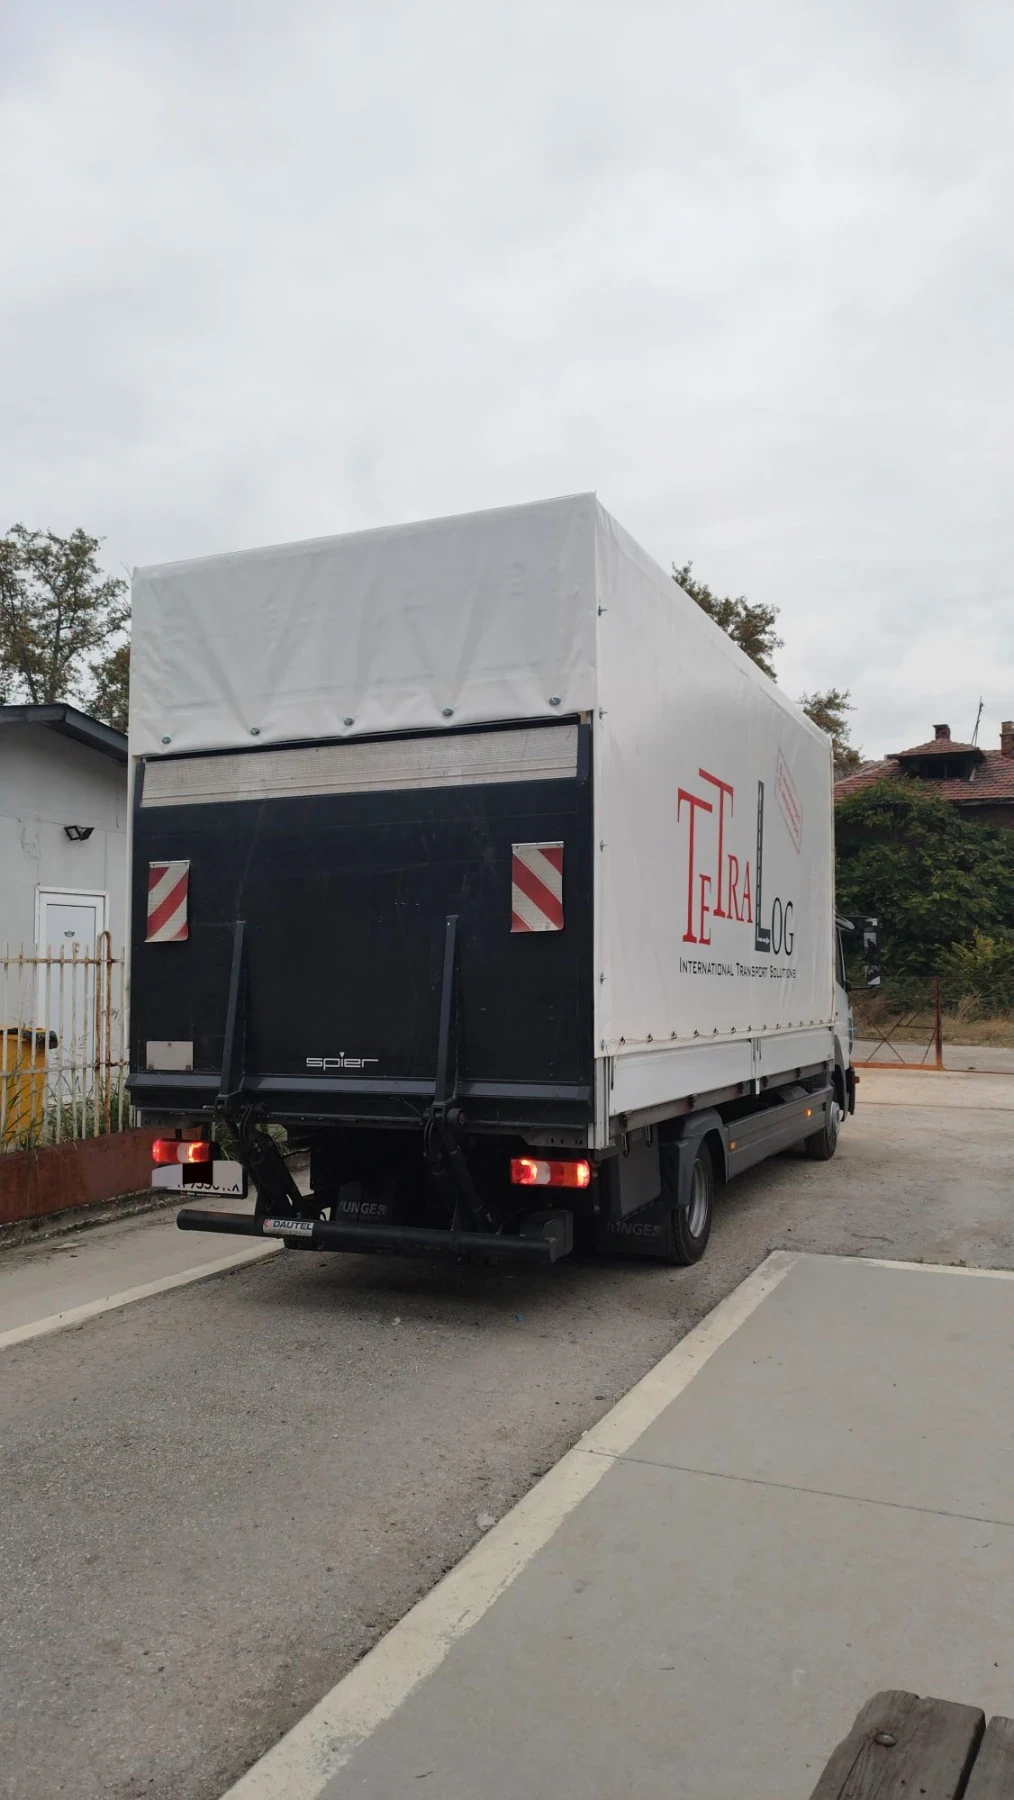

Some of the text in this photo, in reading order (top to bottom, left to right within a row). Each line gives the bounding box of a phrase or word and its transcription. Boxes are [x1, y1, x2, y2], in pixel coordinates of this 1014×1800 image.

[679, 957, 734, 977] INTERNATIONAL
[735, 962, 768, 978] TRANSPORT
[306, 1052, 379, 1071] spier
[272, 1220, 313, 1231] DAUTEL
